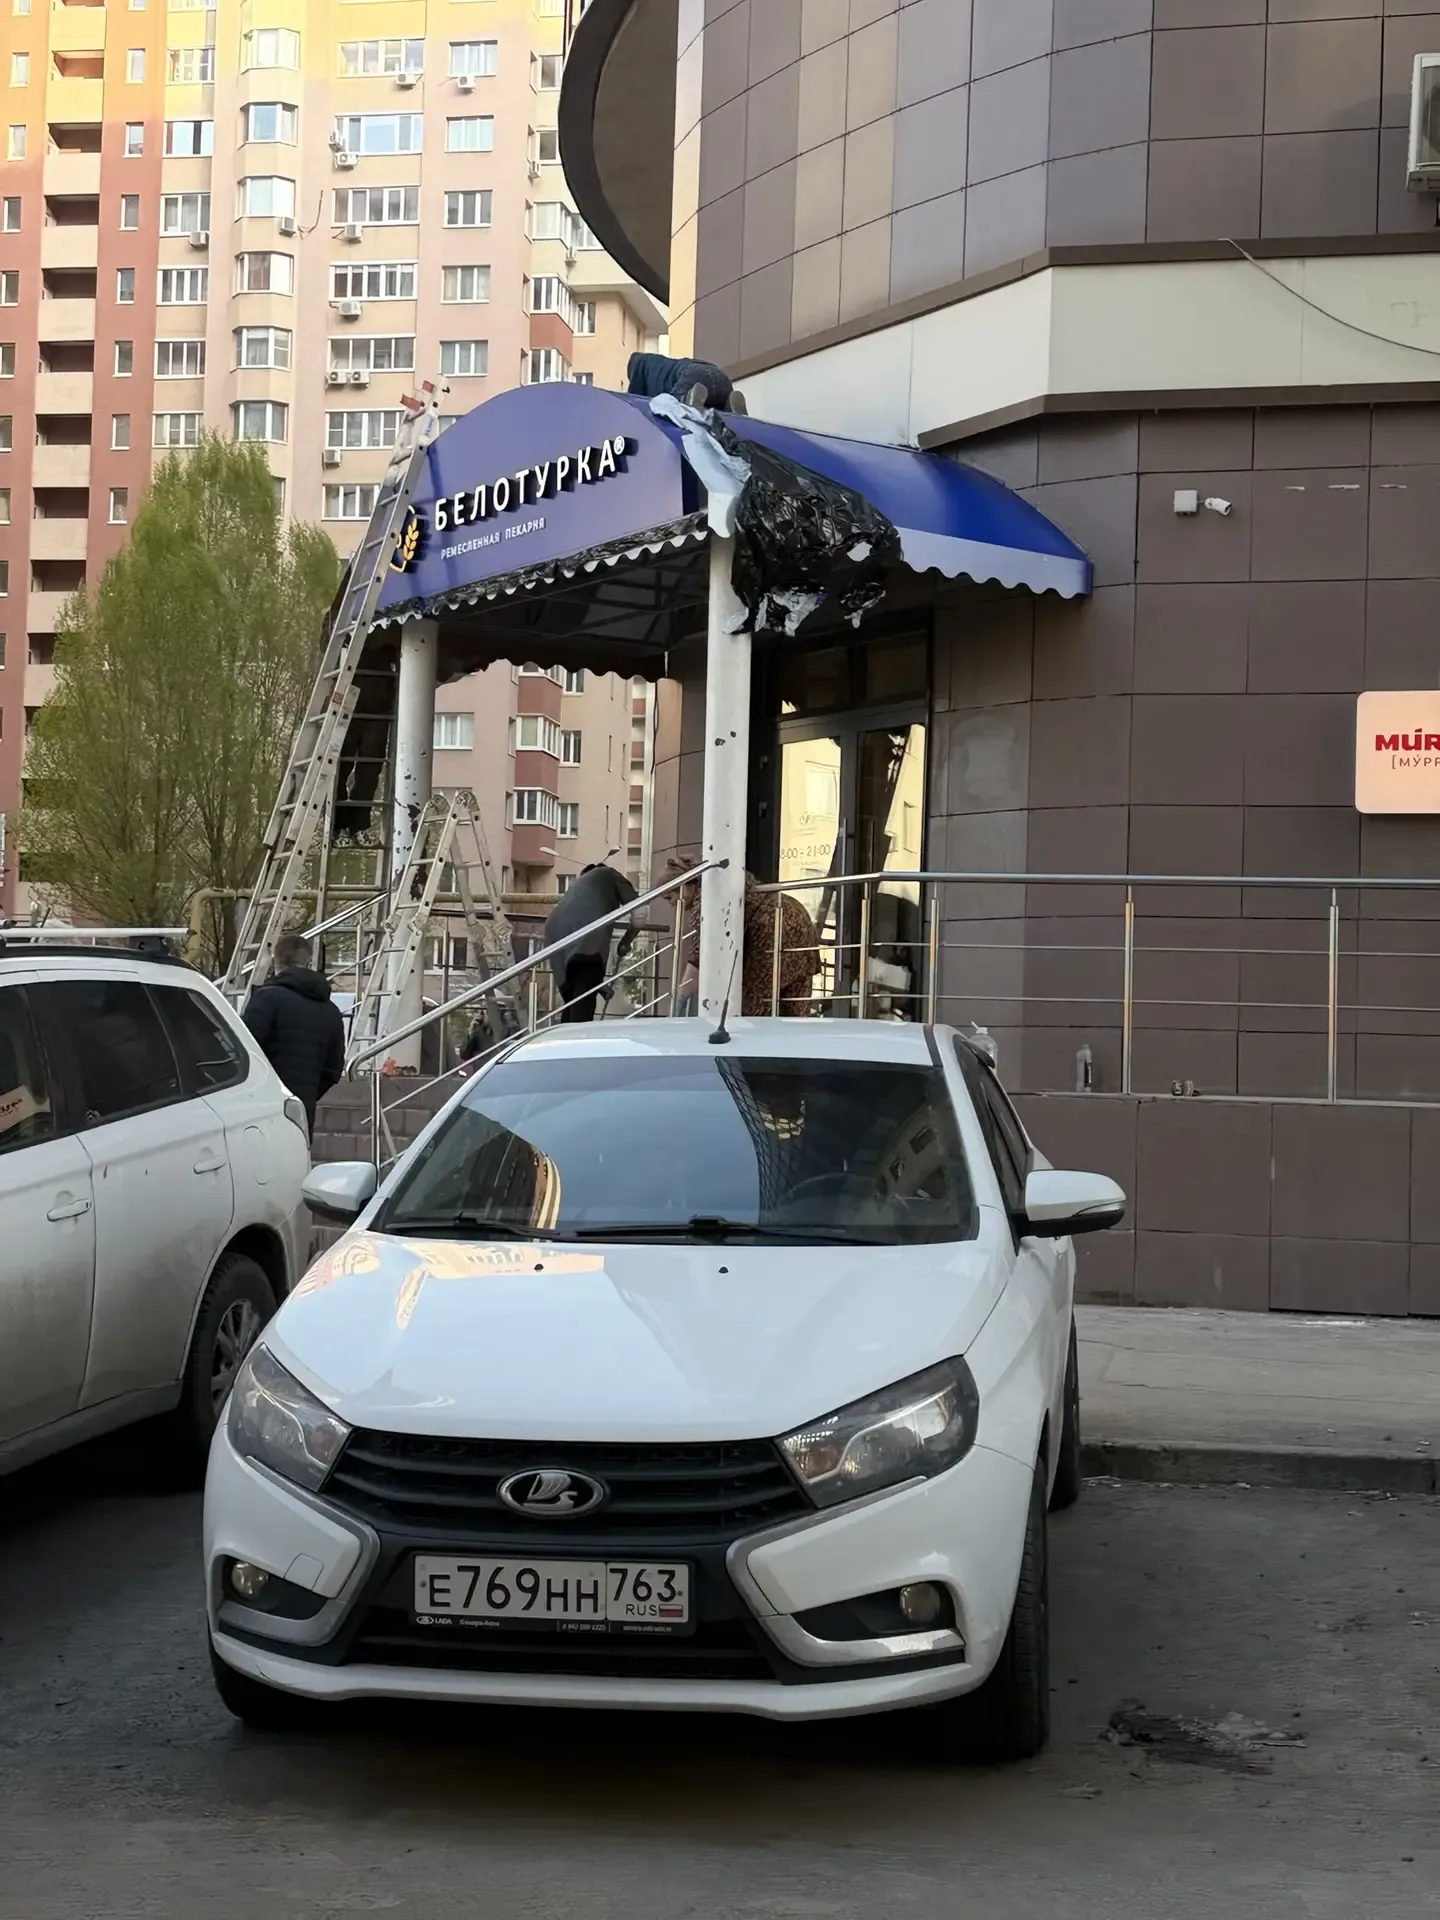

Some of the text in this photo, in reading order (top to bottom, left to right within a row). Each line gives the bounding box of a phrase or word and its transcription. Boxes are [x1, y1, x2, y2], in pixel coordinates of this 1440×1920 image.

[440, 517, 546, 560] РЕМЕСЛЕННАЯ ПЕКАРНЯ
[609, 1567, 676, 1602] 763
[625, 1604, 657, 1616] RUS
